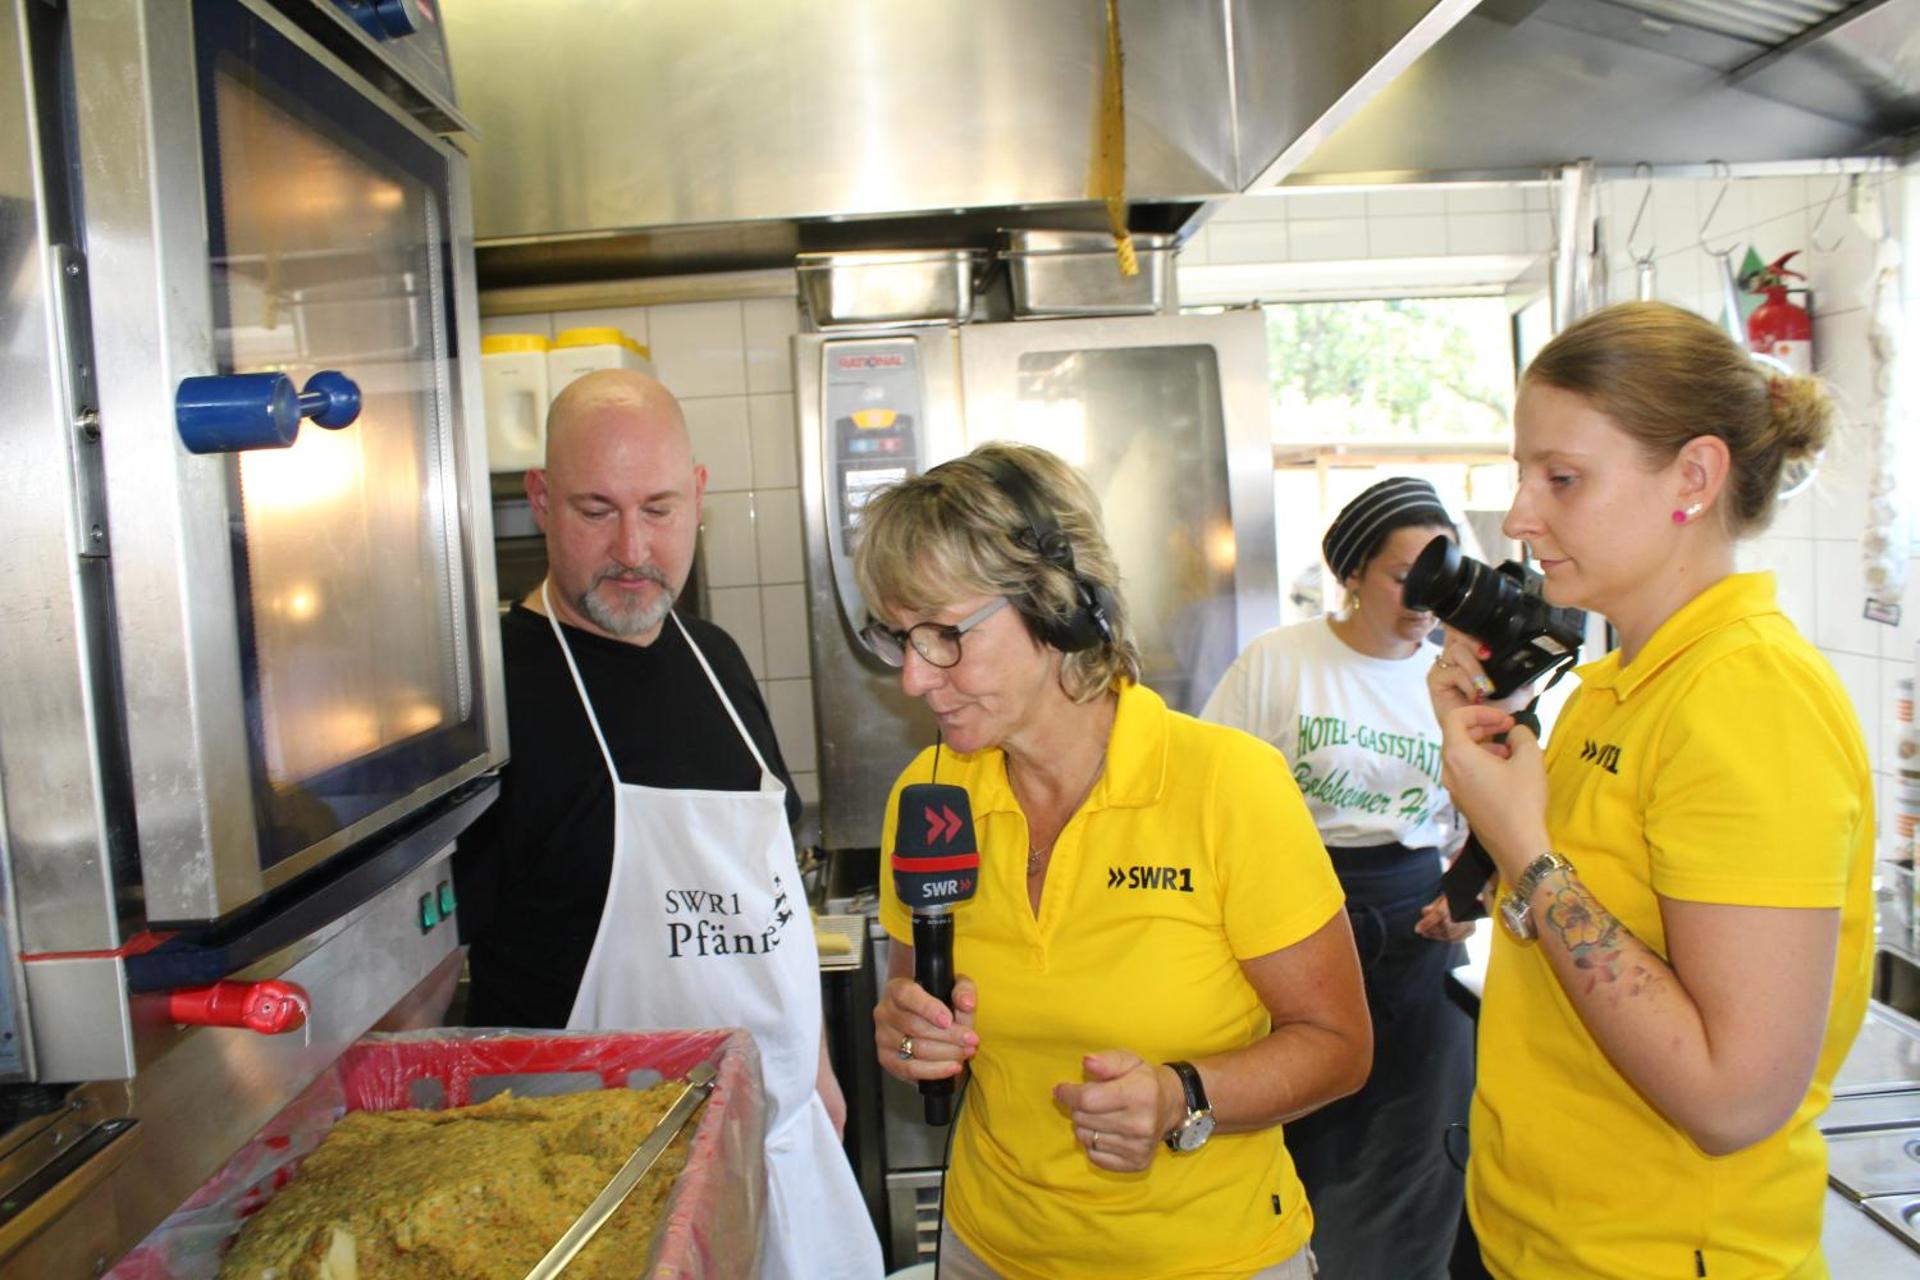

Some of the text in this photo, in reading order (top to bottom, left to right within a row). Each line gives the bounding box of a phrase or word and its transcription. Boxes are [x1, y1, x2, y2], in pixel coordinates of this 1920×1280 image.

[922, 880, 958, 898] SWR
[1128, 866, 1194, 892] SWR1
[665, 889, 742, 916] SWR1
